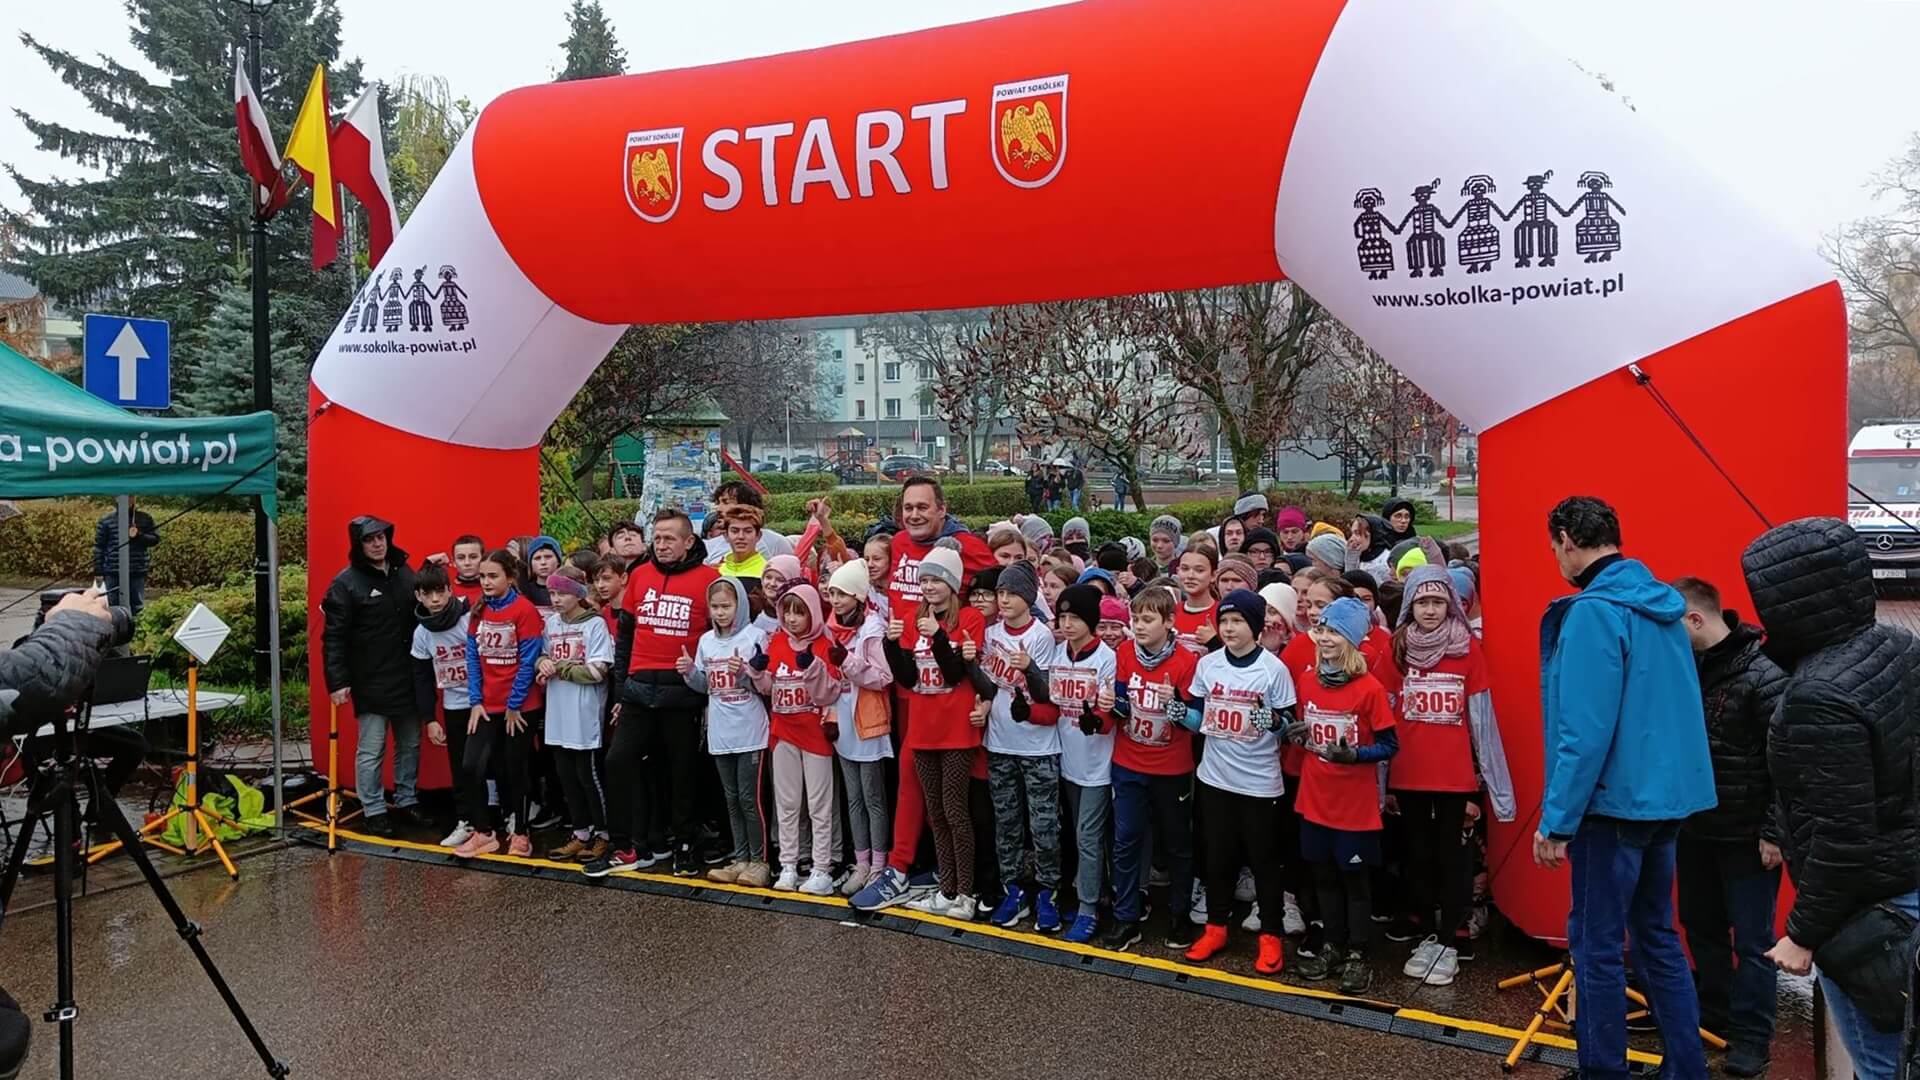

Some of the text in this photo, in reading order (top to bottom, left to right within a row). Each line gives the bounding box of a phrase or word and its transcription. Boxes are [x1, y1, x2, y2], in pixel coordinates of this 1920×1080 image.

[996, 80, 1064, 97] POWIAT SOKÓLSKI
[702, 98, 967, 210] START
[1373, 273, 1624, 307] www.sokolka-powiat.pl
[338, 337, 477, 355] www.sokolka-powiat.pl
[0, 431, 237, 472] a-powiat.pl
[657, 601, 691, 620] BIEG
[486, 632, 503, 648] 22
[555, 643, 571, 660] 59
[921, 668, 944, 687] 43
[991, 655, 1016, 683] 104
[709, 671, 735, 689] 351
[1060, 679, 1086, 700] 105
[776, 687, 805, 707] 258
[1415, 691, 1457, 714] 305
[1132, 716, 1154, 740] 73
[1217, 709, 1243, 732] 90
[1312, 723, 1338, 745] 69
